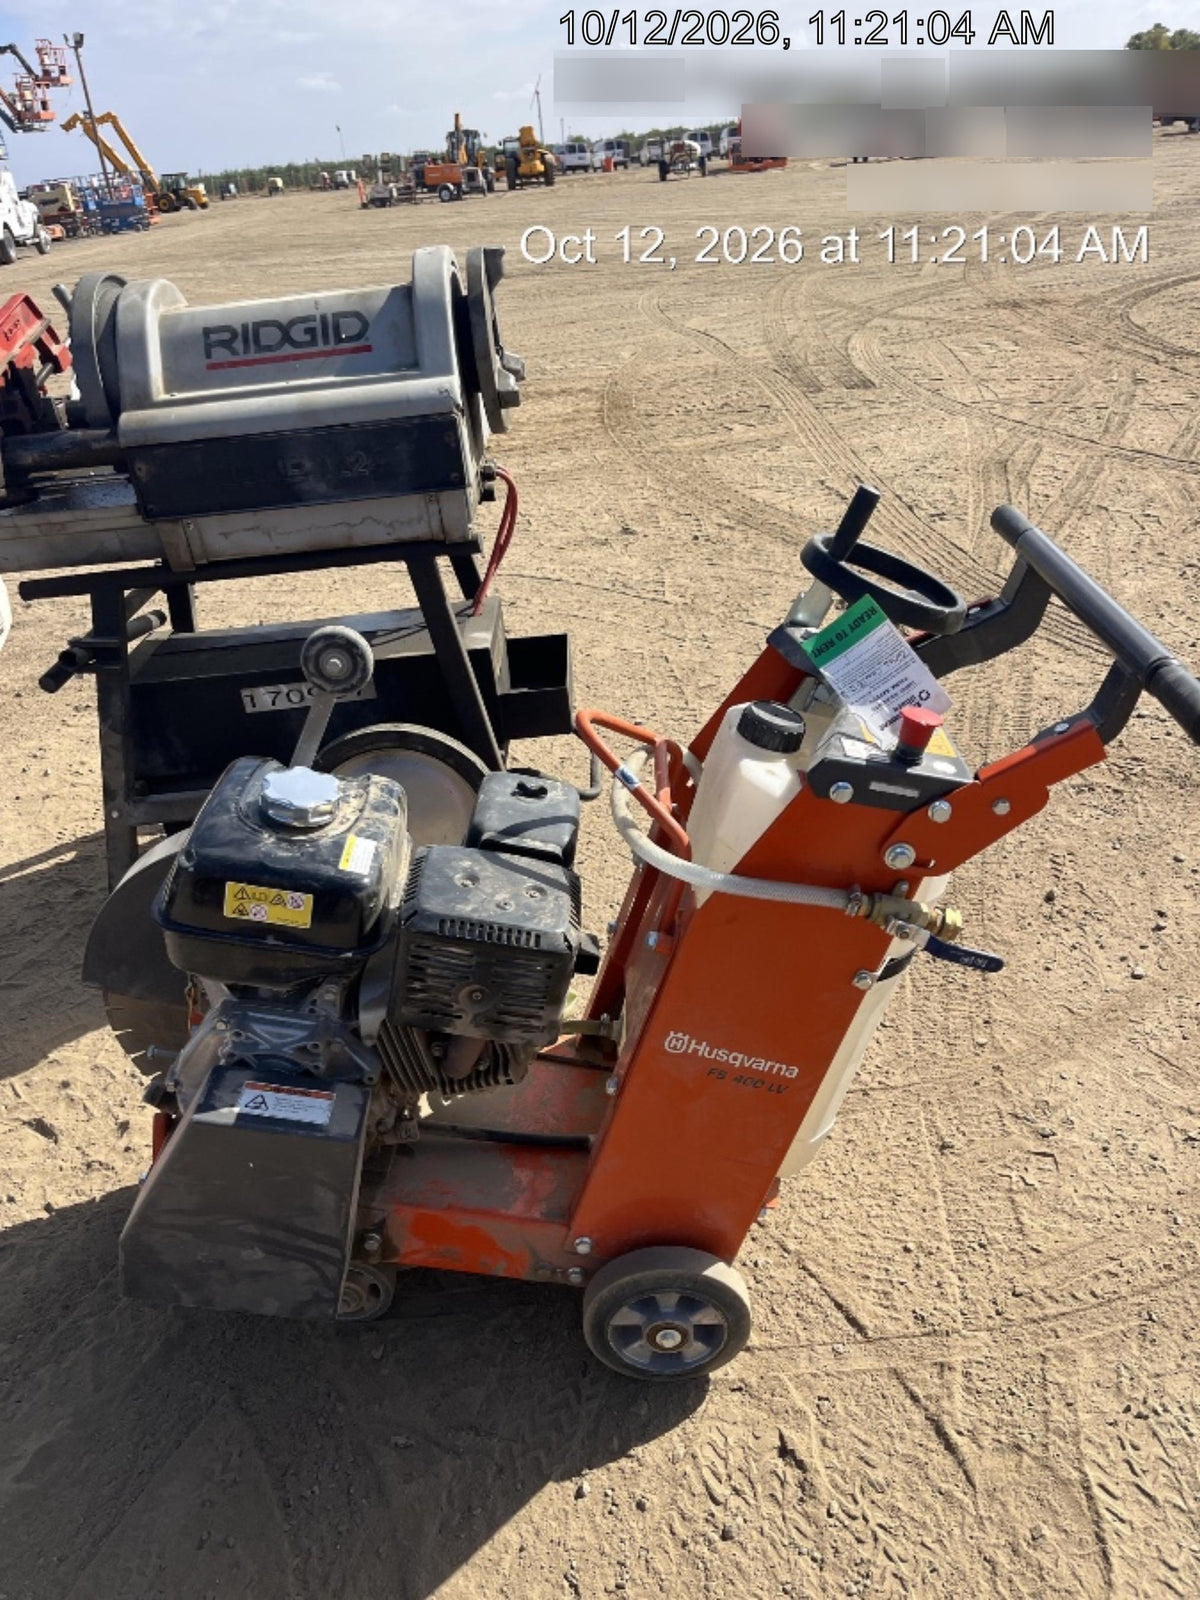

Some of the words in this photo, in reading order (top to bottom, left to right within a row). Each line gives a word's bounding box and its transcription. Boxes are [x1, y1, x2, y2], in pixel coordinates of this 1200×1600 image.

[202, 310, 370, 360] RIDGID
[688, 1039, 800, 1079] Husqvarna
[707, 1068, 728, 1080] FS
[768, 1083, 790, 1094] LV
